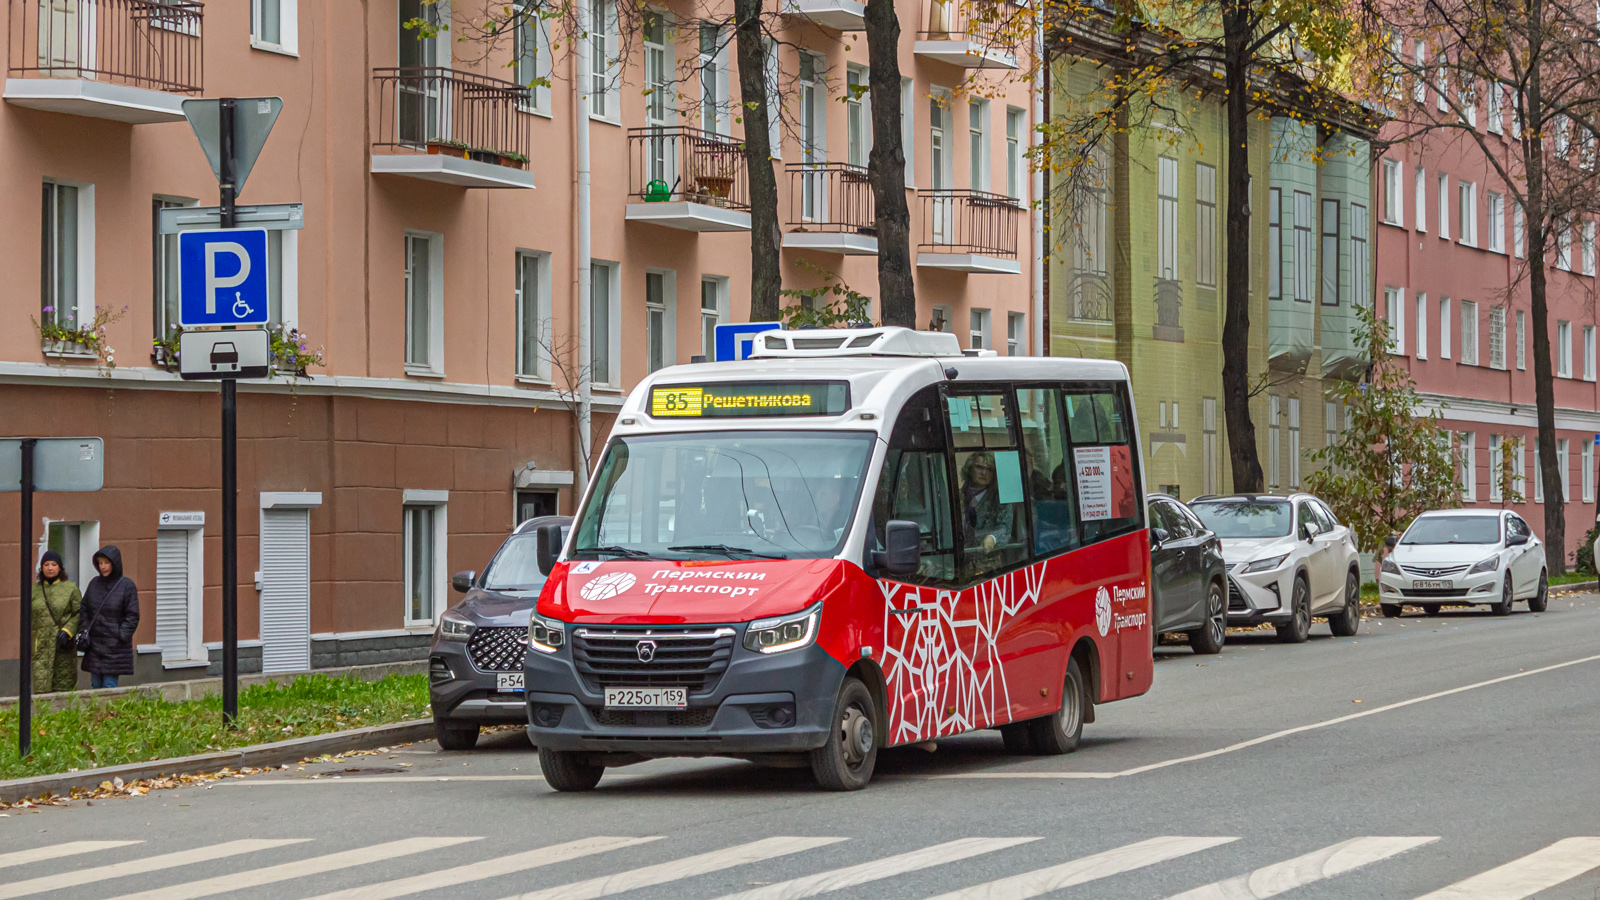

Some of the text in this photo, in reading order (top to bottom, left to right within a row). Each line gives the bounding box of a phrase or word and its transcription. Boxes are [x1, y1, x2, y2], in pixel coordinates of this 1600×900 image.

[205, 241, 251, 314] P
[666, 393, 812, 410] 85 Решетникова
[643, 583, 760, 598] Транспорт
[1113, 581, 1146, 606] Пермский
[1114, 612, 1146, 634] Транспорт
[501, 674, 523, 687] Р54
[663, 690, 683, 702] 159
